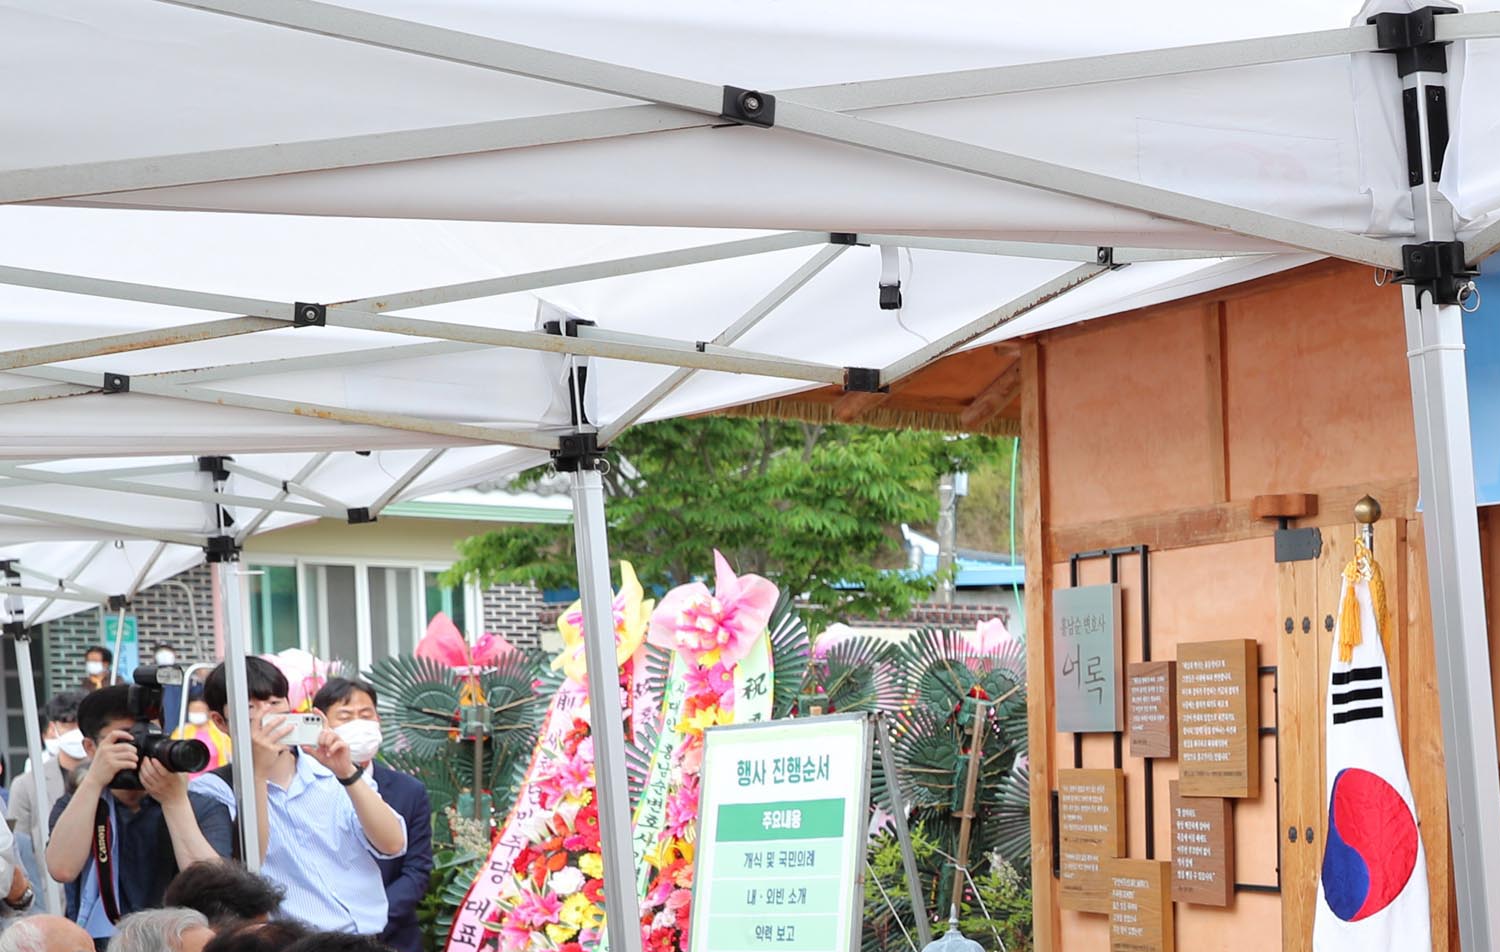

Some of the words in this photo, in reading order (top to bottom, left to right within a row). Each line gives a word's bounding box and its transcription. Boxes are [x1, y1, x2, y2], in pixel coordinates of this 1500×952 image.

[742, 673, 767, 699] 祝
[1063, 643, 1106, 704] 어록
[737, 759, 766, 787] 행사
[772, 754, 830, 784] 진행순서
[762, 809, 802, 830] 주요내용
[97, 825, 108, 863] Canon
[744, 852, 763, 869] 개식
[766, 851, 775, 868] 및
[779, 850, 815, 868] 국민의례
[766, 888, 785, 905] 외빈
[788, 888, 807, 905] 소개
[451, 898, 491, 948] 대표
[755, 925, 773, 942] 약력
[776, 925, 795, 942] 보고
